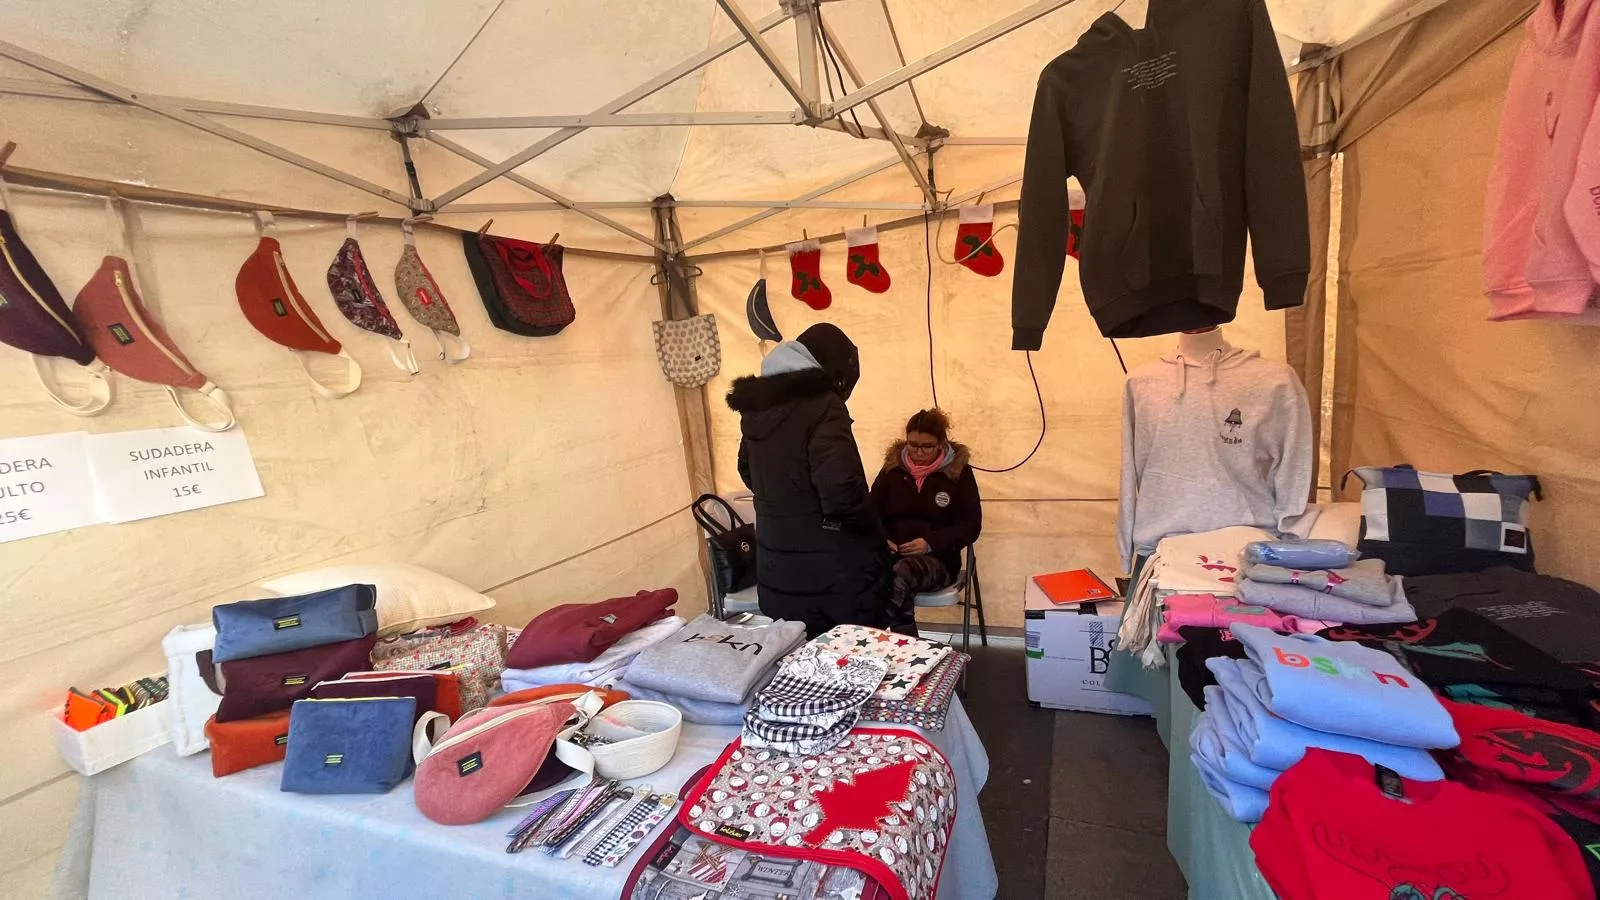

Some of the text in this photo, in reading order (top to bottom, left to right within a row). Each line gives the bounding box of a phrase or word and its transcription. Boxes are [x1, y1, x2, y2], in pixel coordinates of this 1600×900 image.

[129, 441, 215, 462] SUDADERA
[144, 462, 214, 480] INFANTIL
[172, 484, 202, 498] 15€
